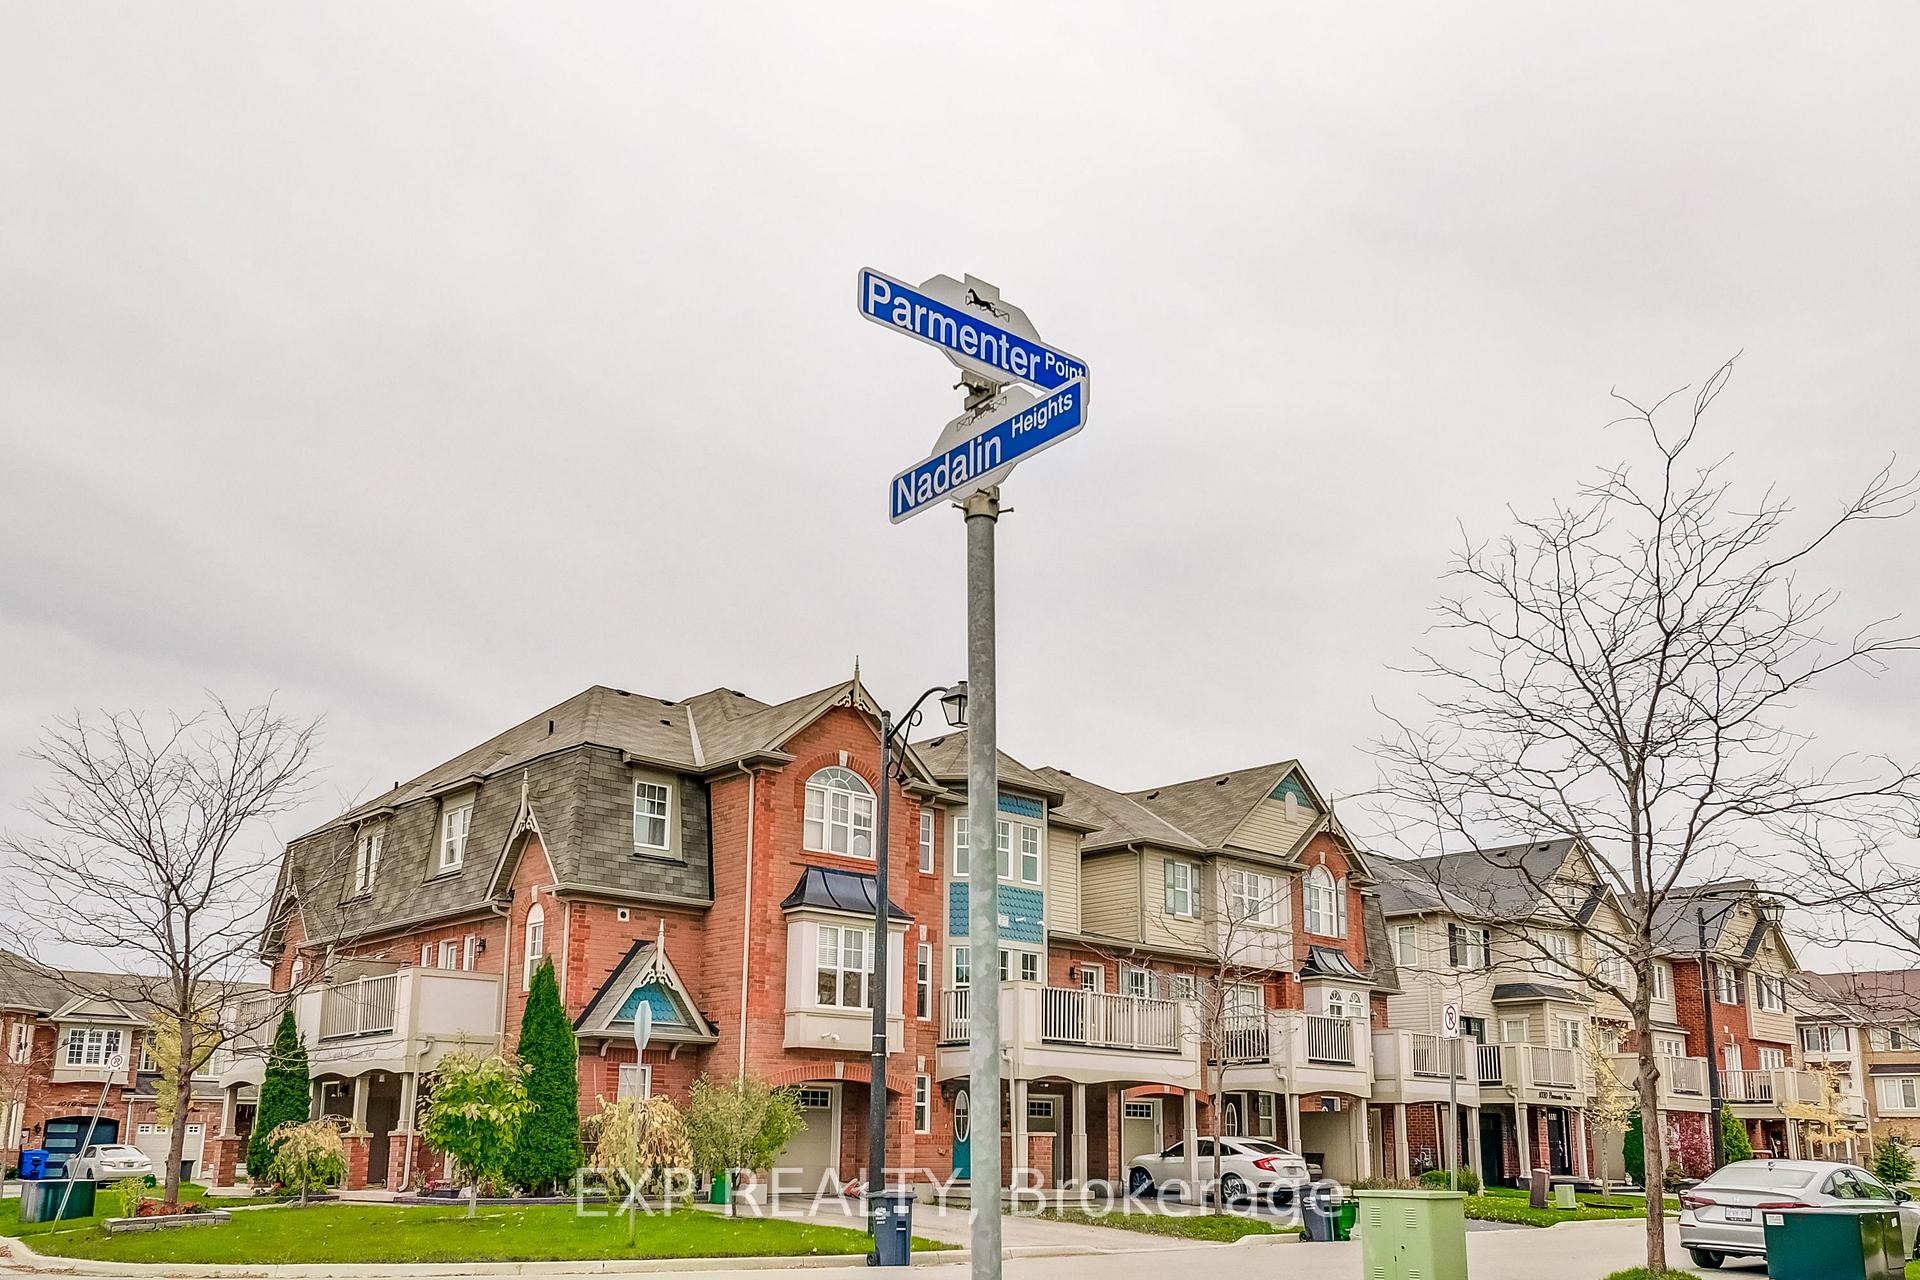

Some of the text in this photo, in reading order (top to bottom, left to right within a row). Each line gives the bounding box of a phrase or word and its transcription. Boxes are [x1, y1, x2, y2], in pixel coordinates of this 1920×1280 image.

[867, 275, 1083, 381] Parmenter Point
[896, 392, 1073, 514] Nadalin Heights
